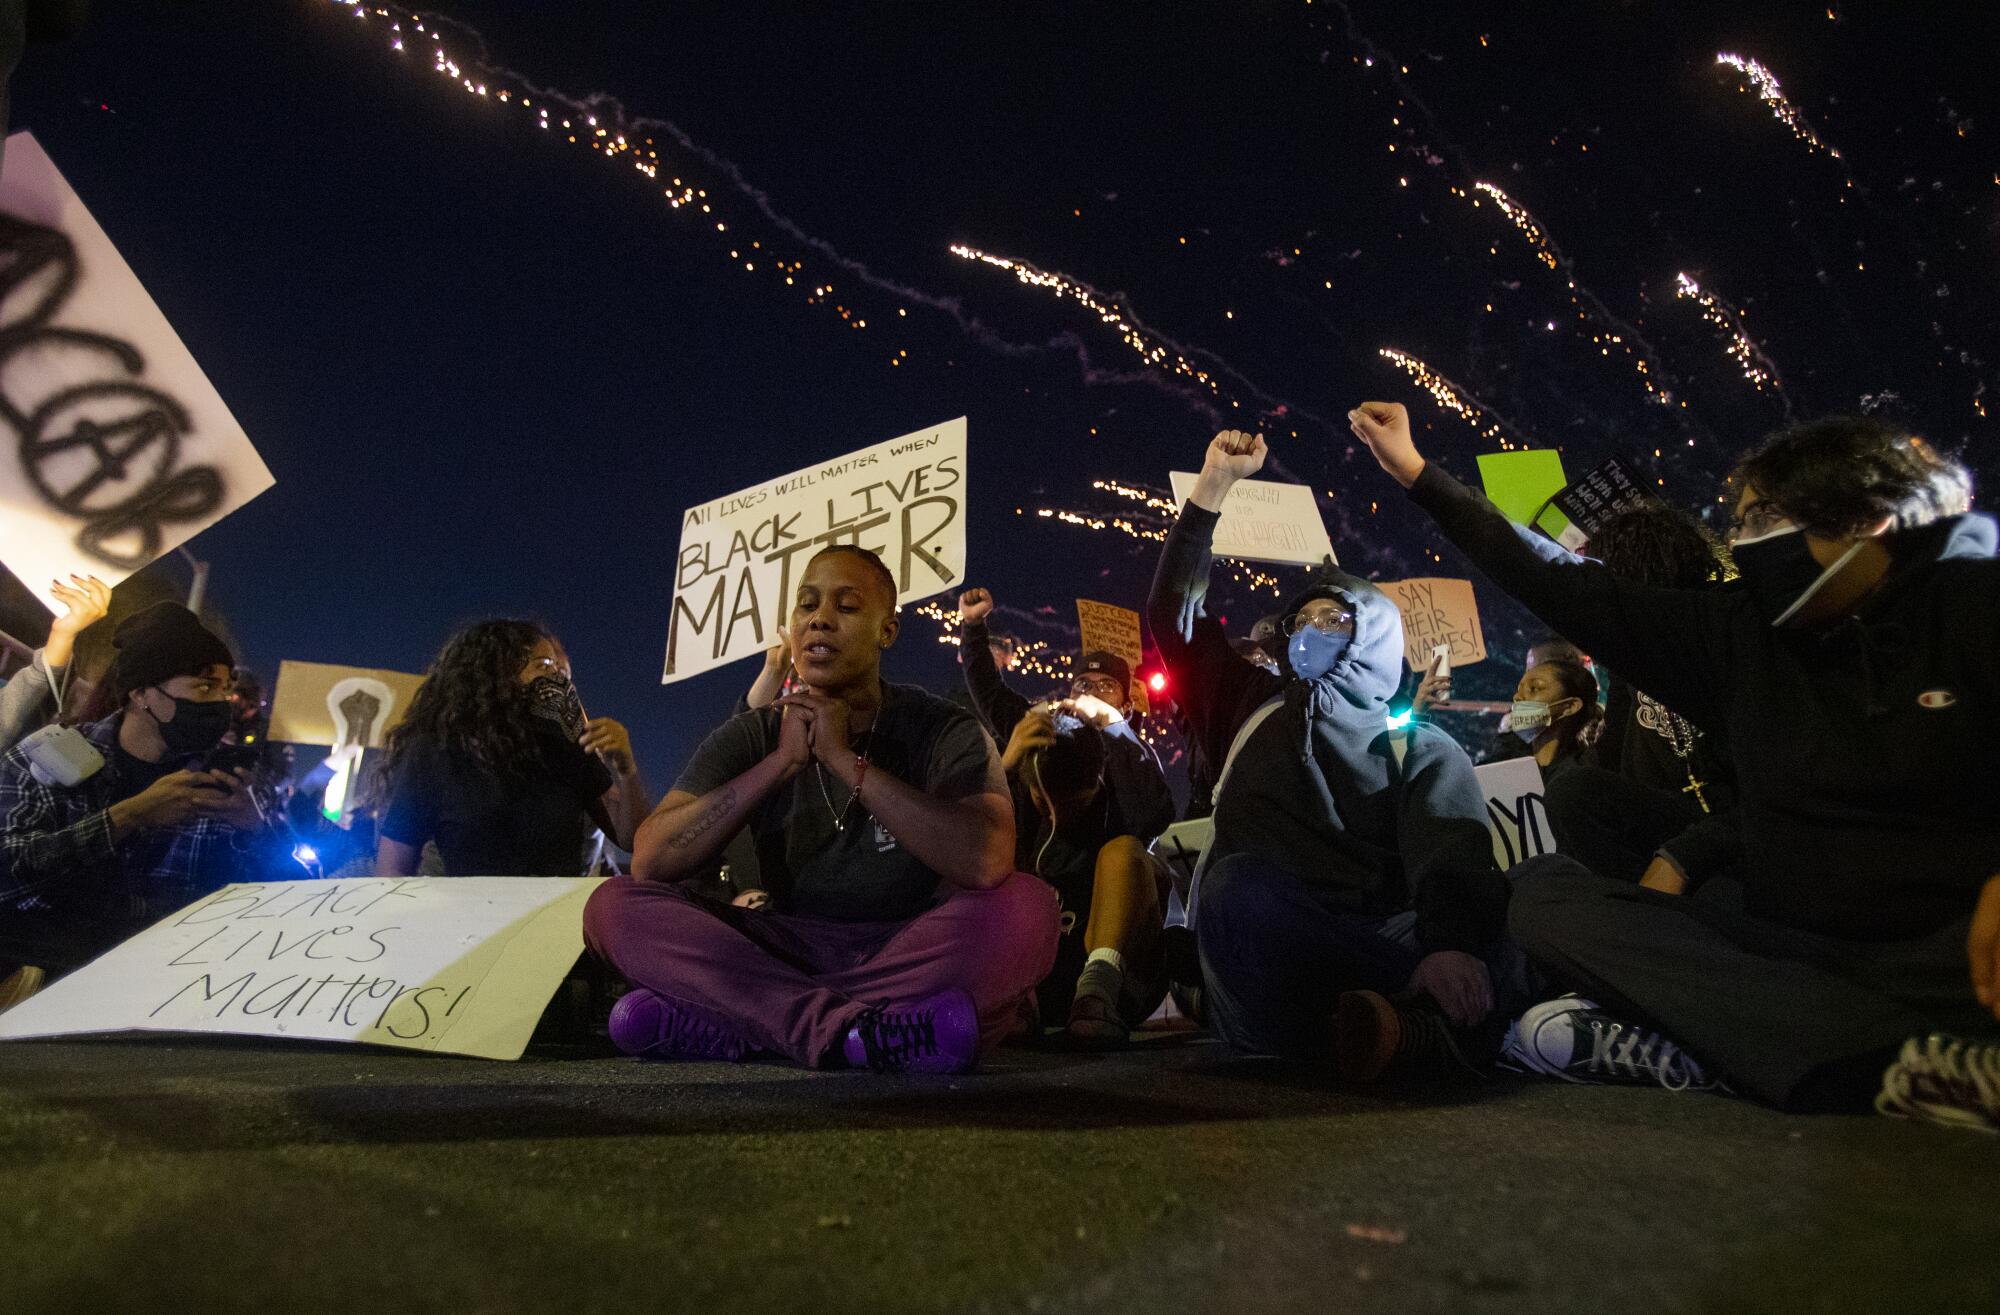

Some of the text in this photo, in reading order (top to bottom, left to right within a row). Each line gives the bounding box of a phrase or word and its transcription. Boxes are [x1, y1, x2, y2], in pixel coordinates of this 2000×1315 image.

[719, 490, 767, 518] LIVES
[775, 474, 816, 496] WILL
[821, 453, 879, 481] MATTER
[890, 434, 939, 457] WHEN
[677, 455, 960, 590] BLACK LIVES
[1398, 583, 1434, 613] SAY
